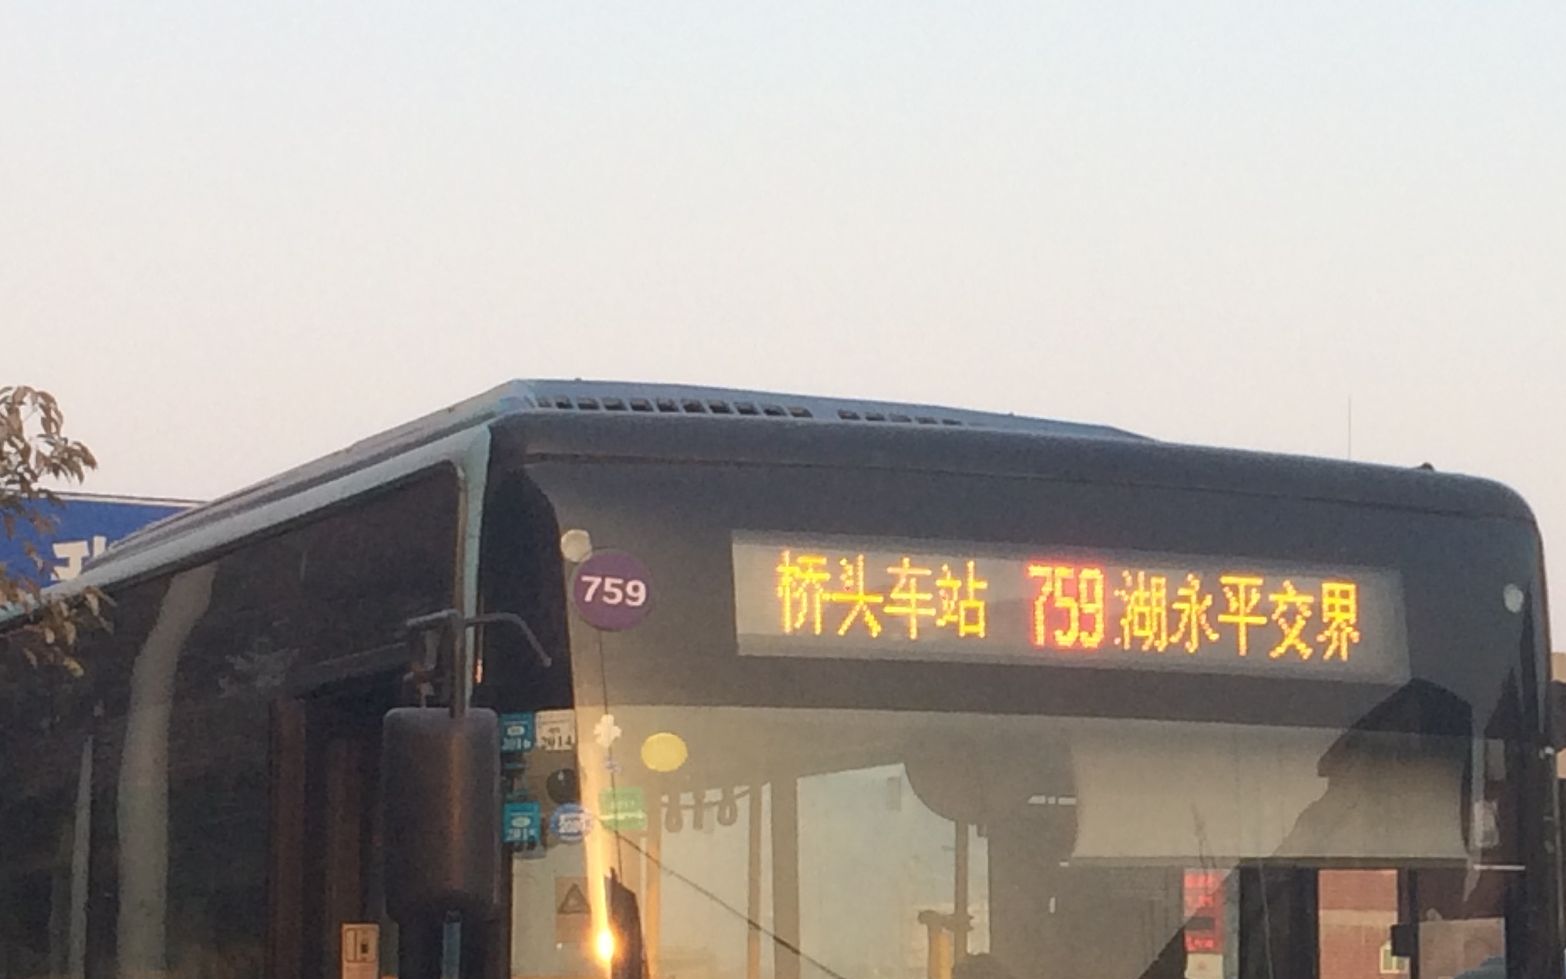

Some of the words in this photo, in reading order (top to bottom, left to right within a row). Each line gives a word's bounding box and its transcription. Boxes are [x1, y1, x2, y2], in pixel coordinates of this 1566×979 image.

[580, 574, 648, 608] 759
[776, 548, 989, 640] 桥头车站
[1027, 562, 1107, 650] 759
[1114, 569, 1362, 662] 湖永平交界
